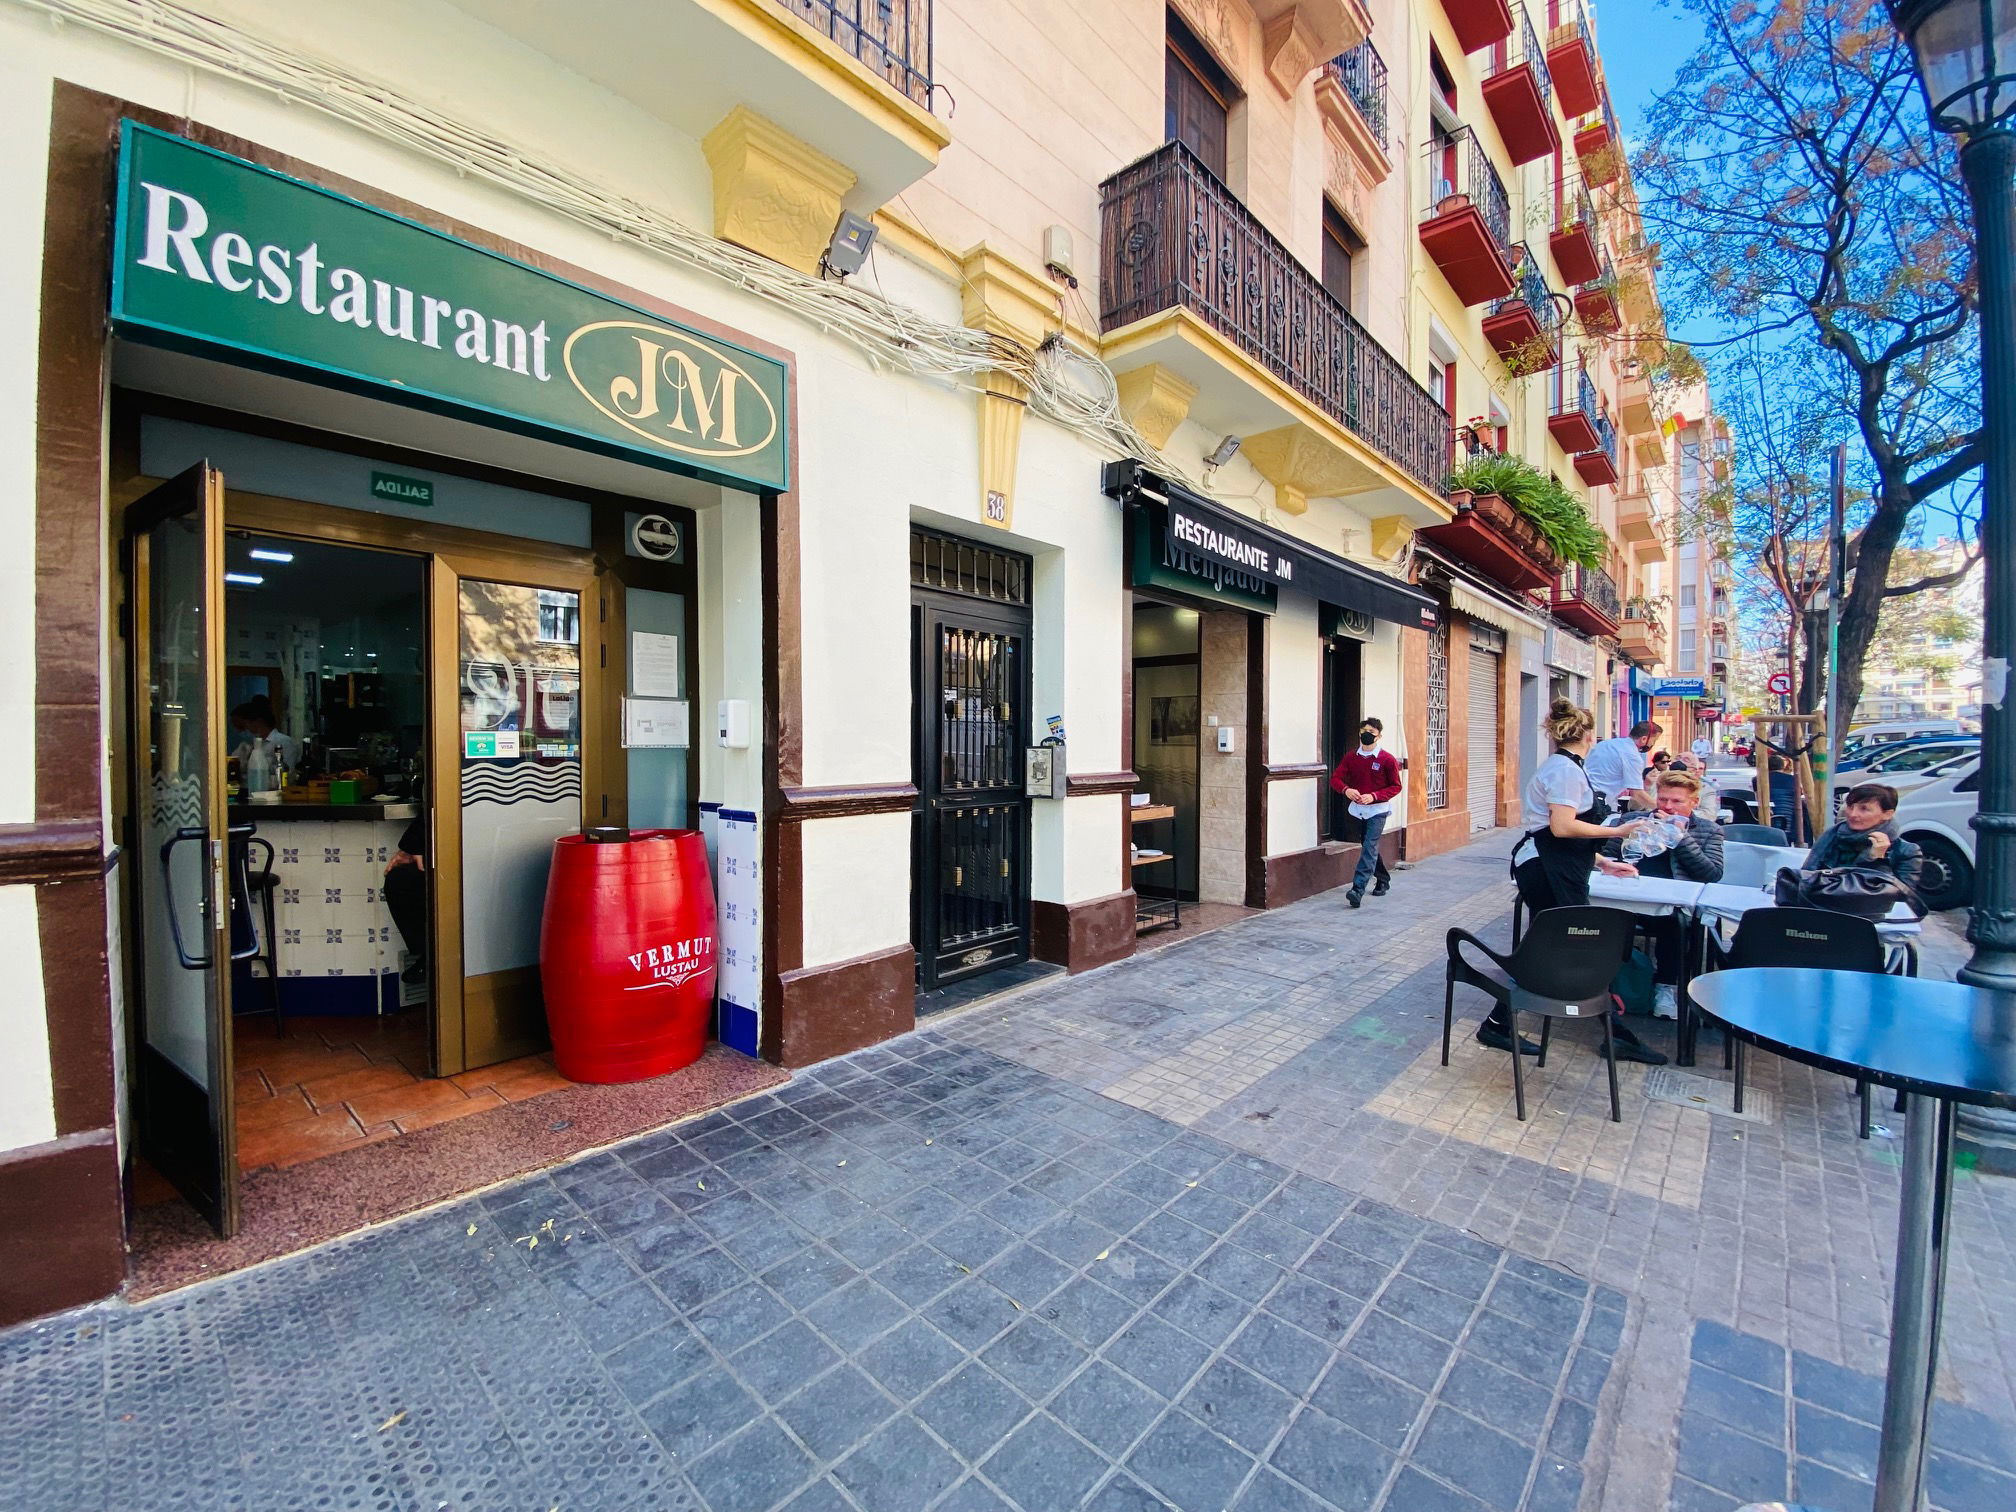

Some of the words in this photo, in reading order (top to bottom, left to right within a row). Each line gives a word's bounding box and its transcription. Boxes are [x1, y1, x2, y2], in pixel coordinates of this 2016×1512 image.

[137, 182, 553, 383] Restaurant
[609, 336, 744, 449] JM
[987, 492, 1004, 520] 38
[1173, 513, 1269, 572] RESTAURANTE
[1275, 557, 1292, 581] JM
[1567, 926, 1600, 936] Mahou
[1786, 928, 1828, 941] Mahou
[628, 936, 712, 972] VERMUT
[654, 958, 699, 978] LUSTAU
